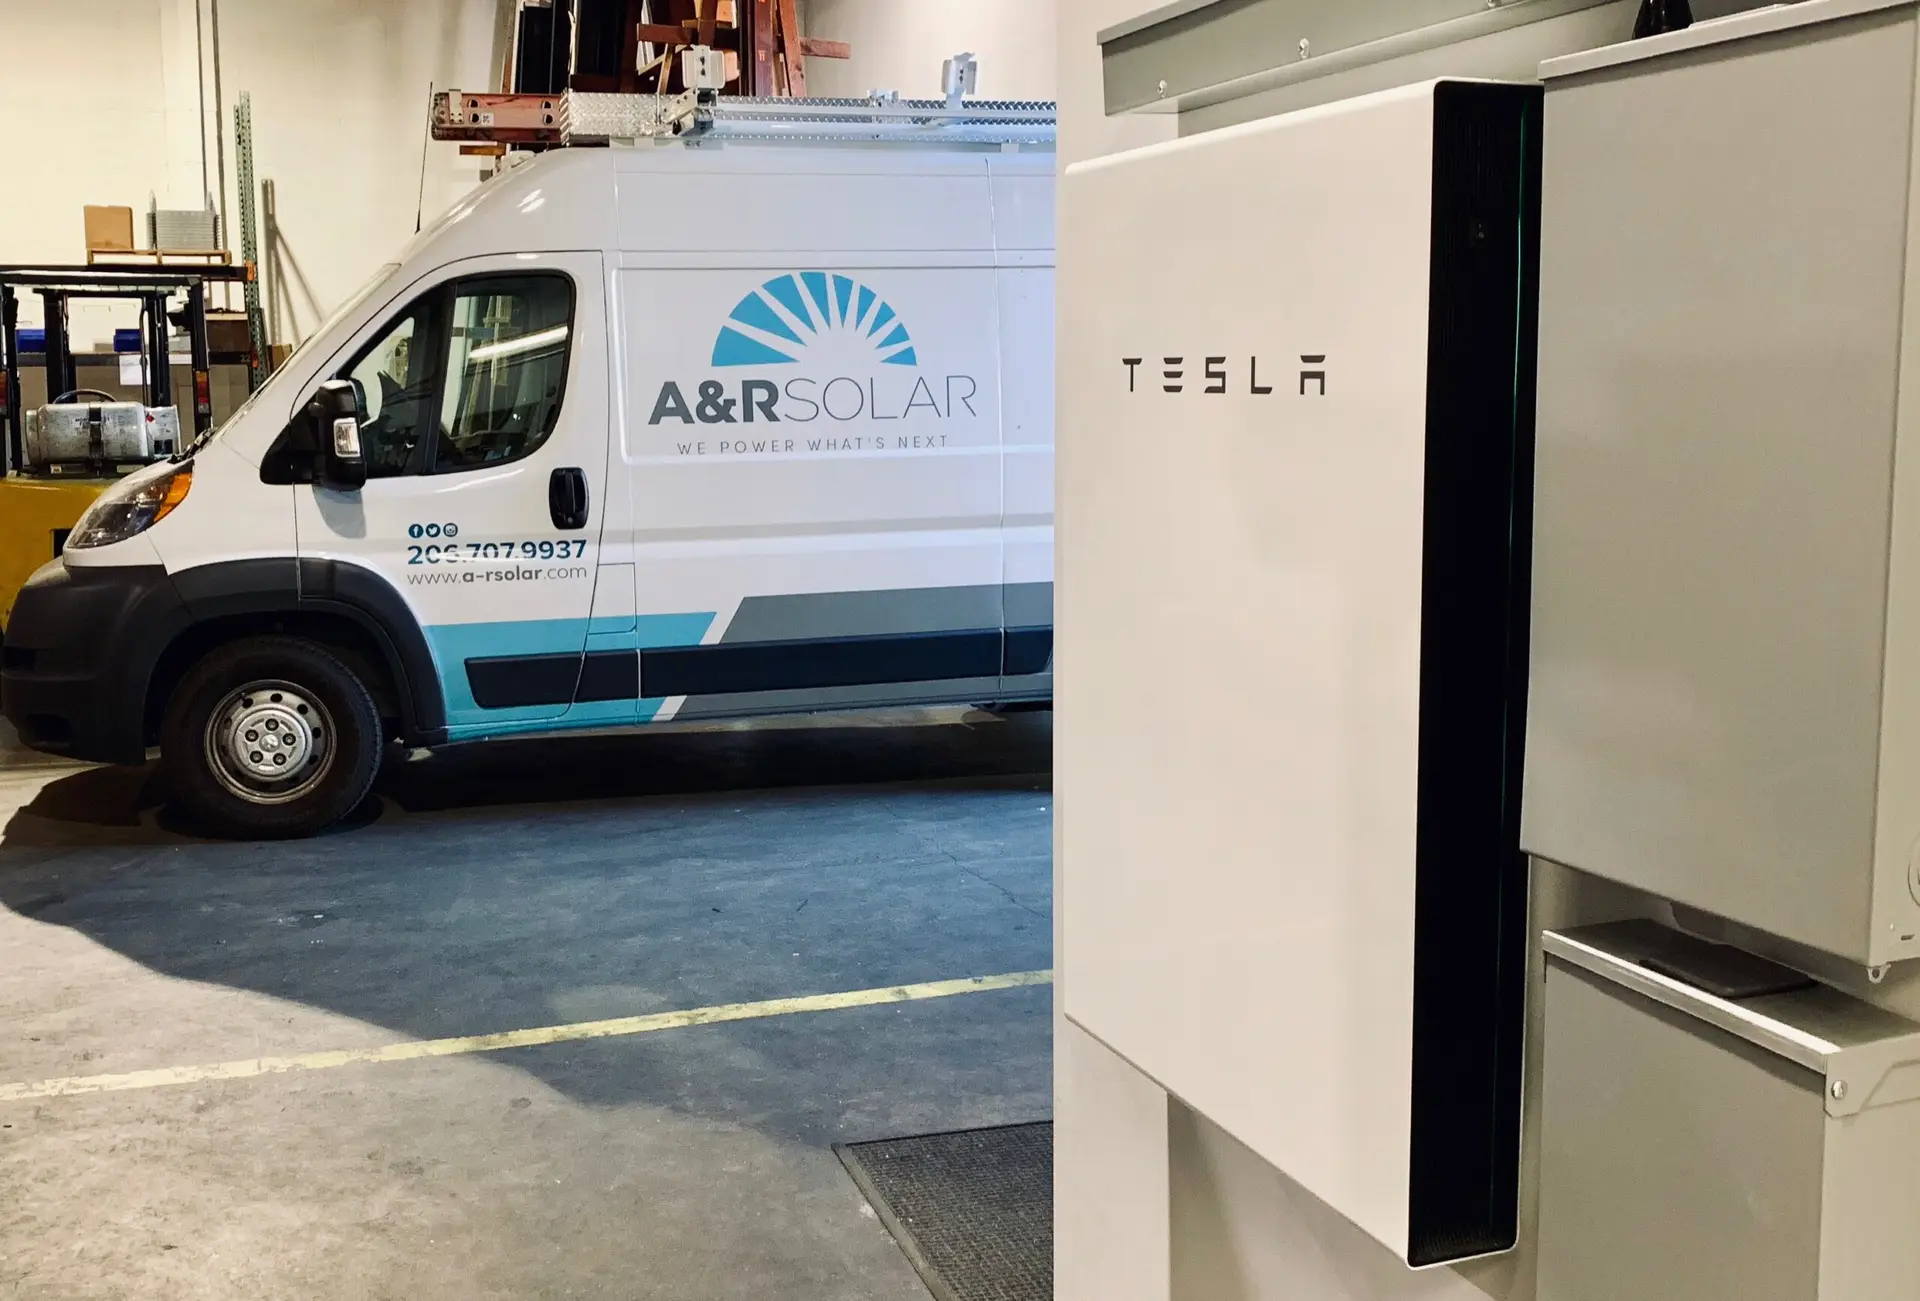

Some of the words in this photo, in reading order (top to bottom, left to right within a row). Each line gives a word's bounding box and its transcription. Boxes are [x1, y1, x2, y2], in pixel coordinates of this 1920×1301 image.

[1121, 354, 1327, 396] TESLA
[676, 441, 706, 455] WE
[719, 439, 795, 454] POWER
[806, 435, 886, 452] WHAT'S
[897, 434, 948, 449] NEXT
[406, 564, 588, 586] www.a-rsolar.com
